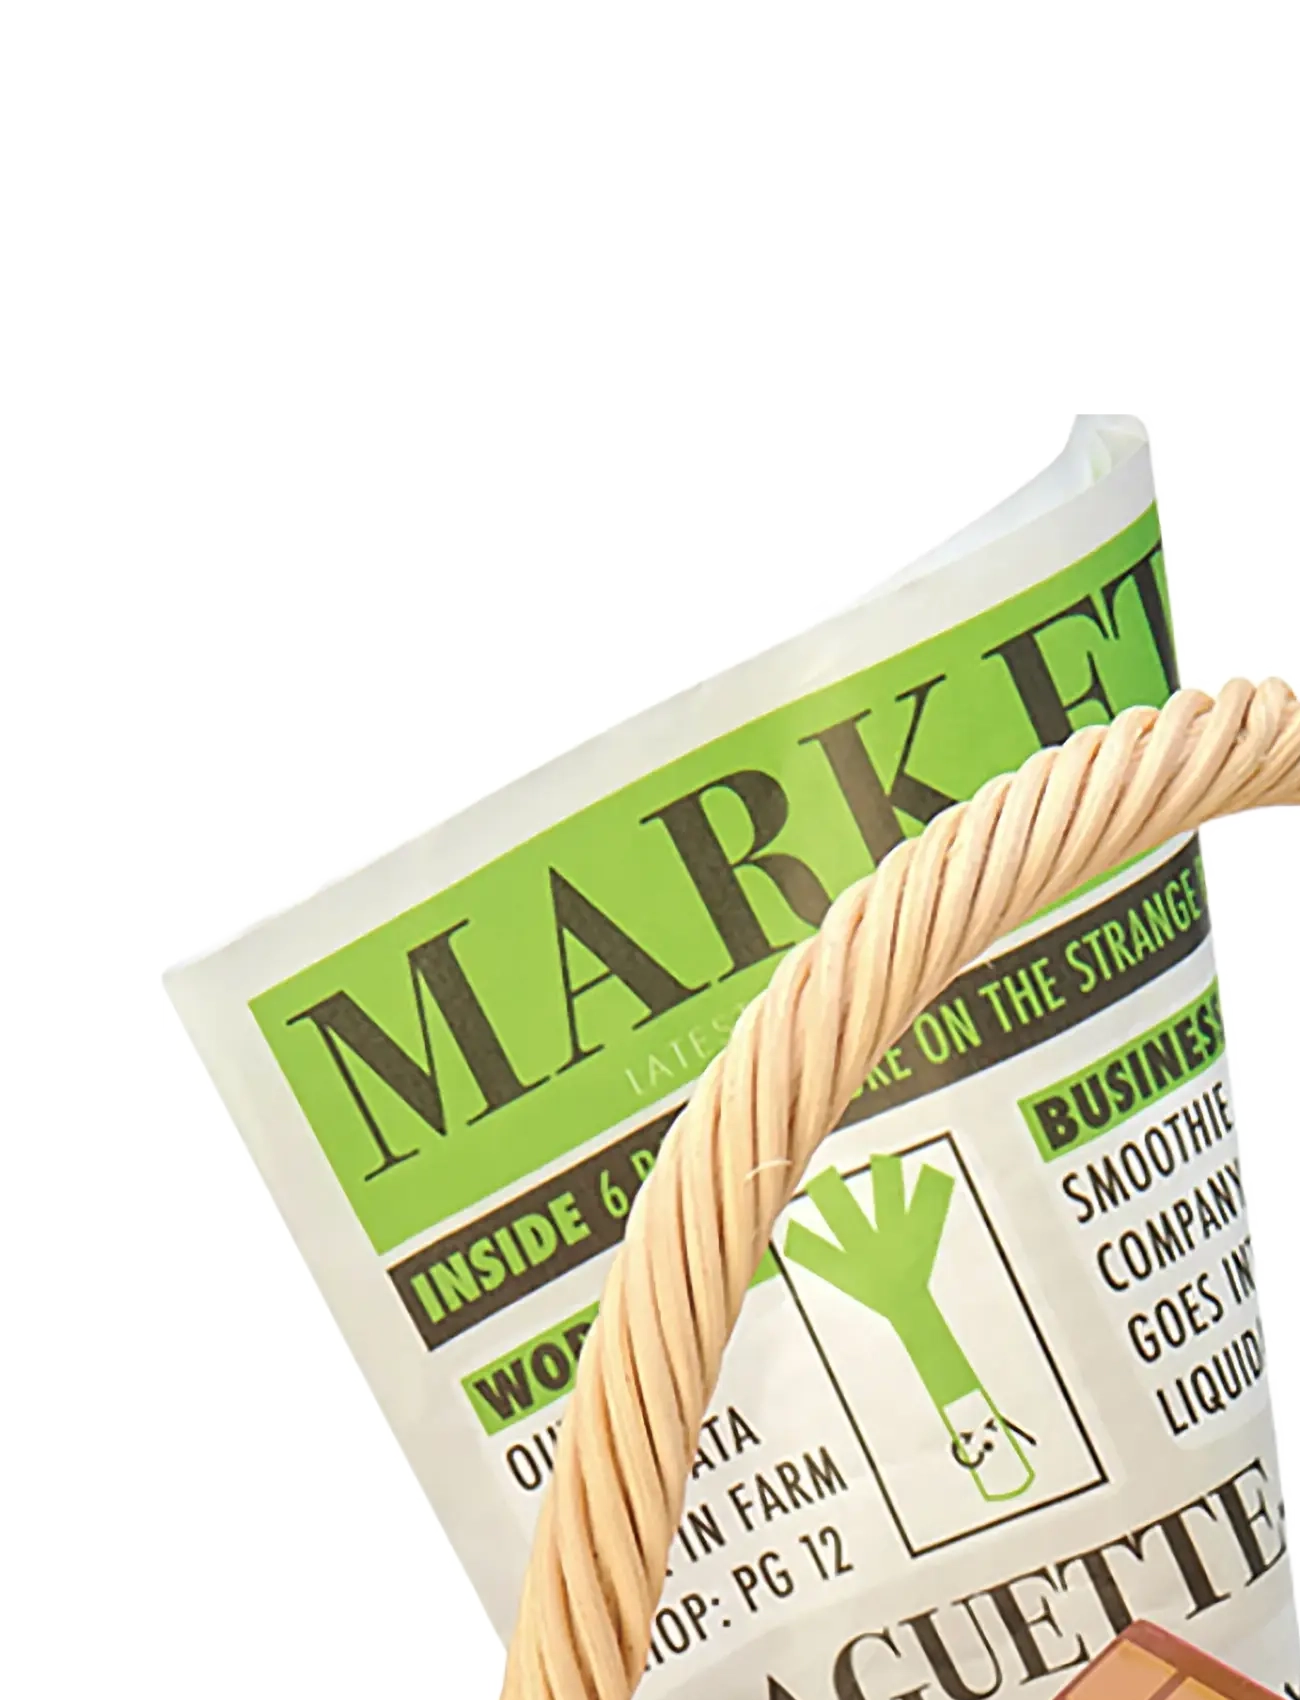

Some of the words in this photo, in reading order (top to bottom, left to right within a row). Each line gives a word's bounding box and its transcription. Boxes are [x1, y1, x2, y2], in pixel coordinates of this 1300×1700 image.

[410, 1192, 591, 1324] INSIDE
[599, 1170, 629, 1219] 6
[914, 984, 975, 1064] ON
[978, 956, 1066, 1032] THE
[1062, 1081, 1235, 1224] SMOOTHIE
[1127, 1273, 1224, 1364] GOES
[1221, 1238, 1257, 1305] IN
[1156, 1322, 1266, 1436] LIQUID
[727, 1446, 848, 1532] FARM
[731, 1551, 795, 1613] PG
[799, 1525, 854, 1581] 12
